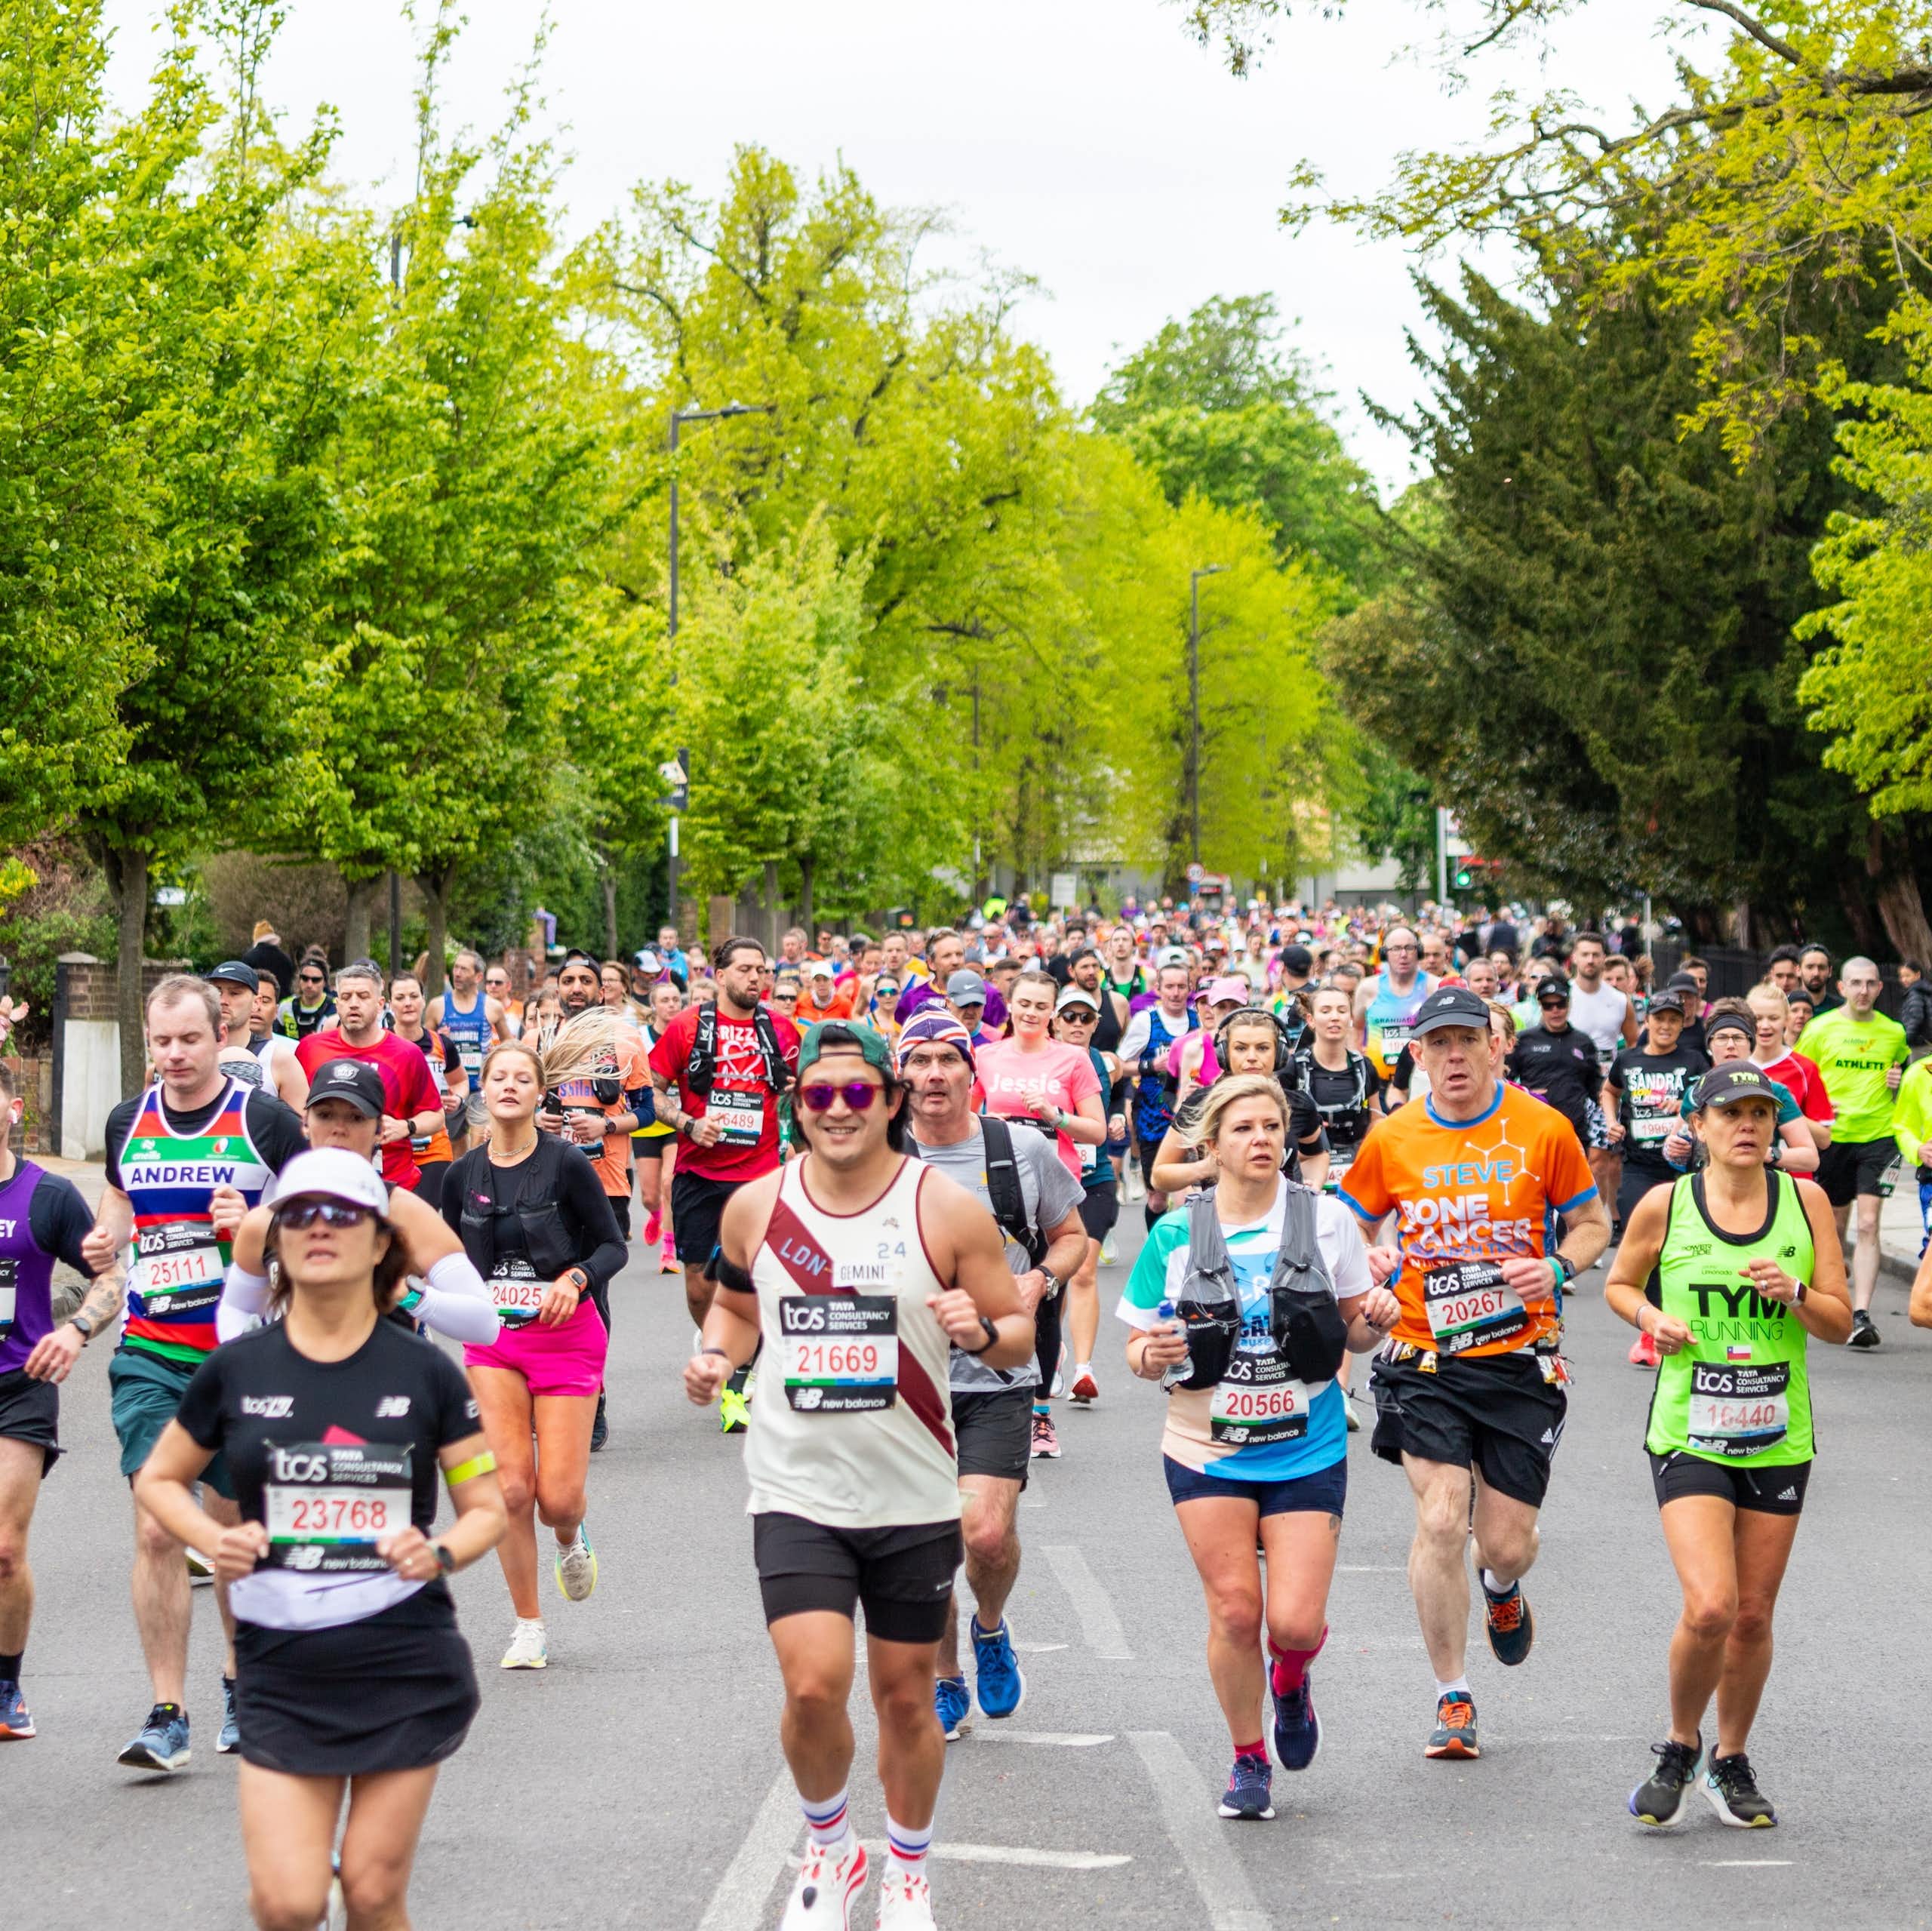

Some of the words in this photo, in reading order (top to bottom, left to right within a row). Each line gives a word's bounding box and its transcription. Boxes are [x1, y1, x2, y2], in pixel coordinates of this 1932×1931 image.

[989, 1073, 1061, 1094] Jessie
[1628, 1072, 1684, 1091] SANDRA
[1729, 1072, 1760, 1084] TYM
[711, 1090, 731, 1105] tcs
[131, 1167, 235, 1184] ANDREW
[1423, 1161, 1514, 1188] STEVE
[1400, 1194, 1490, 1225] BONE
[140, 1233, 165, 1253] tcs
[166, 1231, 211, 1241] CONSULTANCY
[166, 1238, 194, 1249] SERVICES
[780, 1238, 827, 1276] LDN
[878, 1241, 906, 1259] 24
[151, 1255, 205, 1285] 25111
[841, 1265, 885, 1281] GEMINI
[1429, 1273, 1460, 1296] tcs
[1460, 1265, 1481, 1274] TATA
[1463, 1277, 1493, 1290] SERVICES
[171, 1302, 187, 1310] new
[187, 1295, 220, 1308] balance
[493, 1286, 542, 1306] 24025
[1688, 1284, 1787, 1319] TYM
[784, 1302, 825, 1330] tcs
[829, 1302, 855, 1311] TATA
[829, 1311, 890, 1320] CONSULTANCY
[1442, 1290, 1504, 1325] 20267
[829, 1321, 868, 1330] SERVICES
[1475, 1334, 1491, 1345] new
[1491, 1323, 1523, 1338] balance
[1690, 1321, 1784, 1341] RUNNING
[798, 1345, 878, 1373] 21669
[1255, 1358, 1276, 1366] TATA
[1255, 1371, 1286, 1382] SERVICES
[1697, 1367, 1733, 1392] tcs
[1737, 1375, 1786, 1385] CONSULTANCY
[1736, 1385, 1768, 1394] SERVICES
[823, 1401, 844, 1409] new
[844, 1398, 886, 1408] balance
[1226, 1390, 1294, 1416] 20566
[1707, 1404, 1776, 1428] 16440
[1249, 1434, 1266, 1444] new
[1267, 1428, 1300, 1442] balance
[274, 1449, 328, 1483] tcs
[331, 1450, 365, 1461] TATA
[331, 1461, 404, 1474] CONSULTANCY
[331, 1473, 378, 1484] SERVICES
[292, 1500, 387, 1530] 23768
[322, 1560, 346, 1570] new
